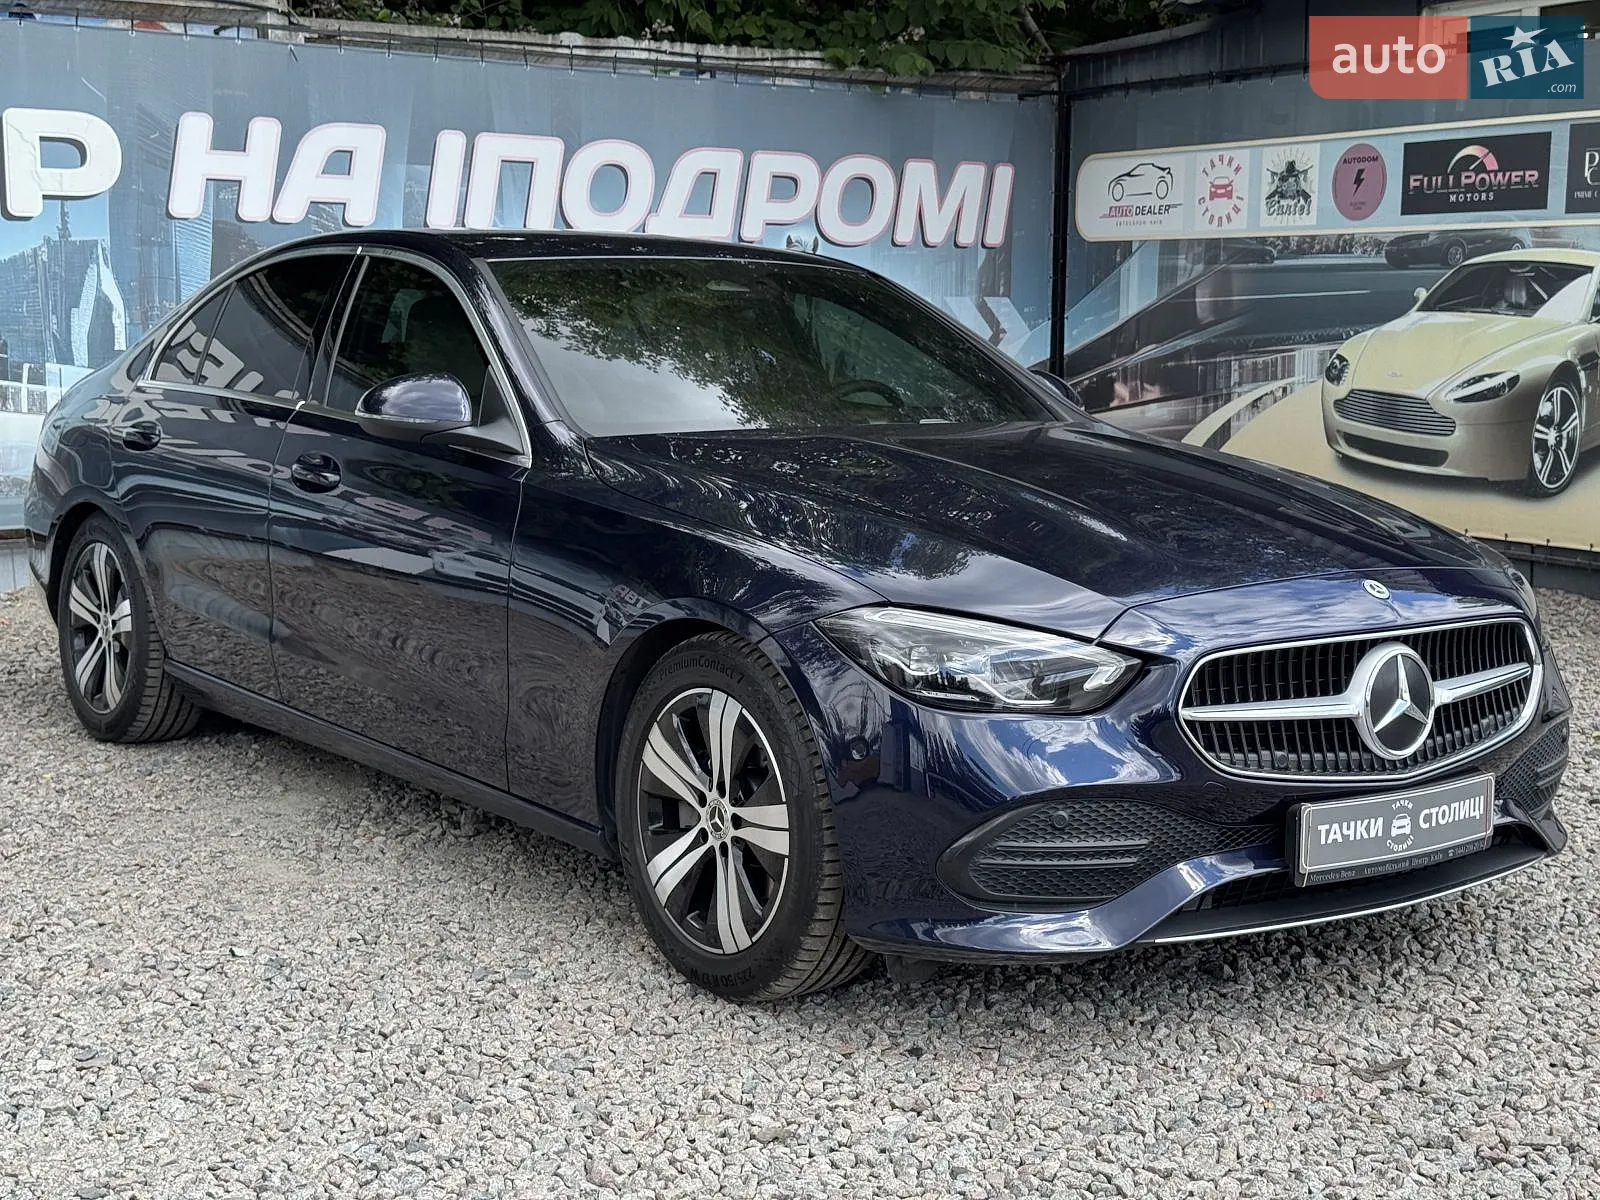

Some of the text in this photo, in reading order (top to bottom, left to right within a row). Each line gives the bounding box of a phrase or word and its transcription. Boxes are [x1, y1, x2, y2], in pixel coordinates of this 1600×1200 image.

[1202, 154, 1243, 177] ТАЧКИ
[1343, 156, 1379, 165] AUTODOM
[168, 112, 387, 226] НА
[426, 129, 1015, 249] ІПОДРОМІ
[1449, 191, 1495, 203] MOTORS
[1109, 204, 1171, 217] AUTO DEALER
[657, 655, 736, 681] PremiumContact
[1391, 799, 1414, 811] ТАЧКИ
[1317, 795, 1484, 845] ТАЧКИ СТОЛИЦІ
[1386, 834, 1415, 852] СТОЛИЦІ
